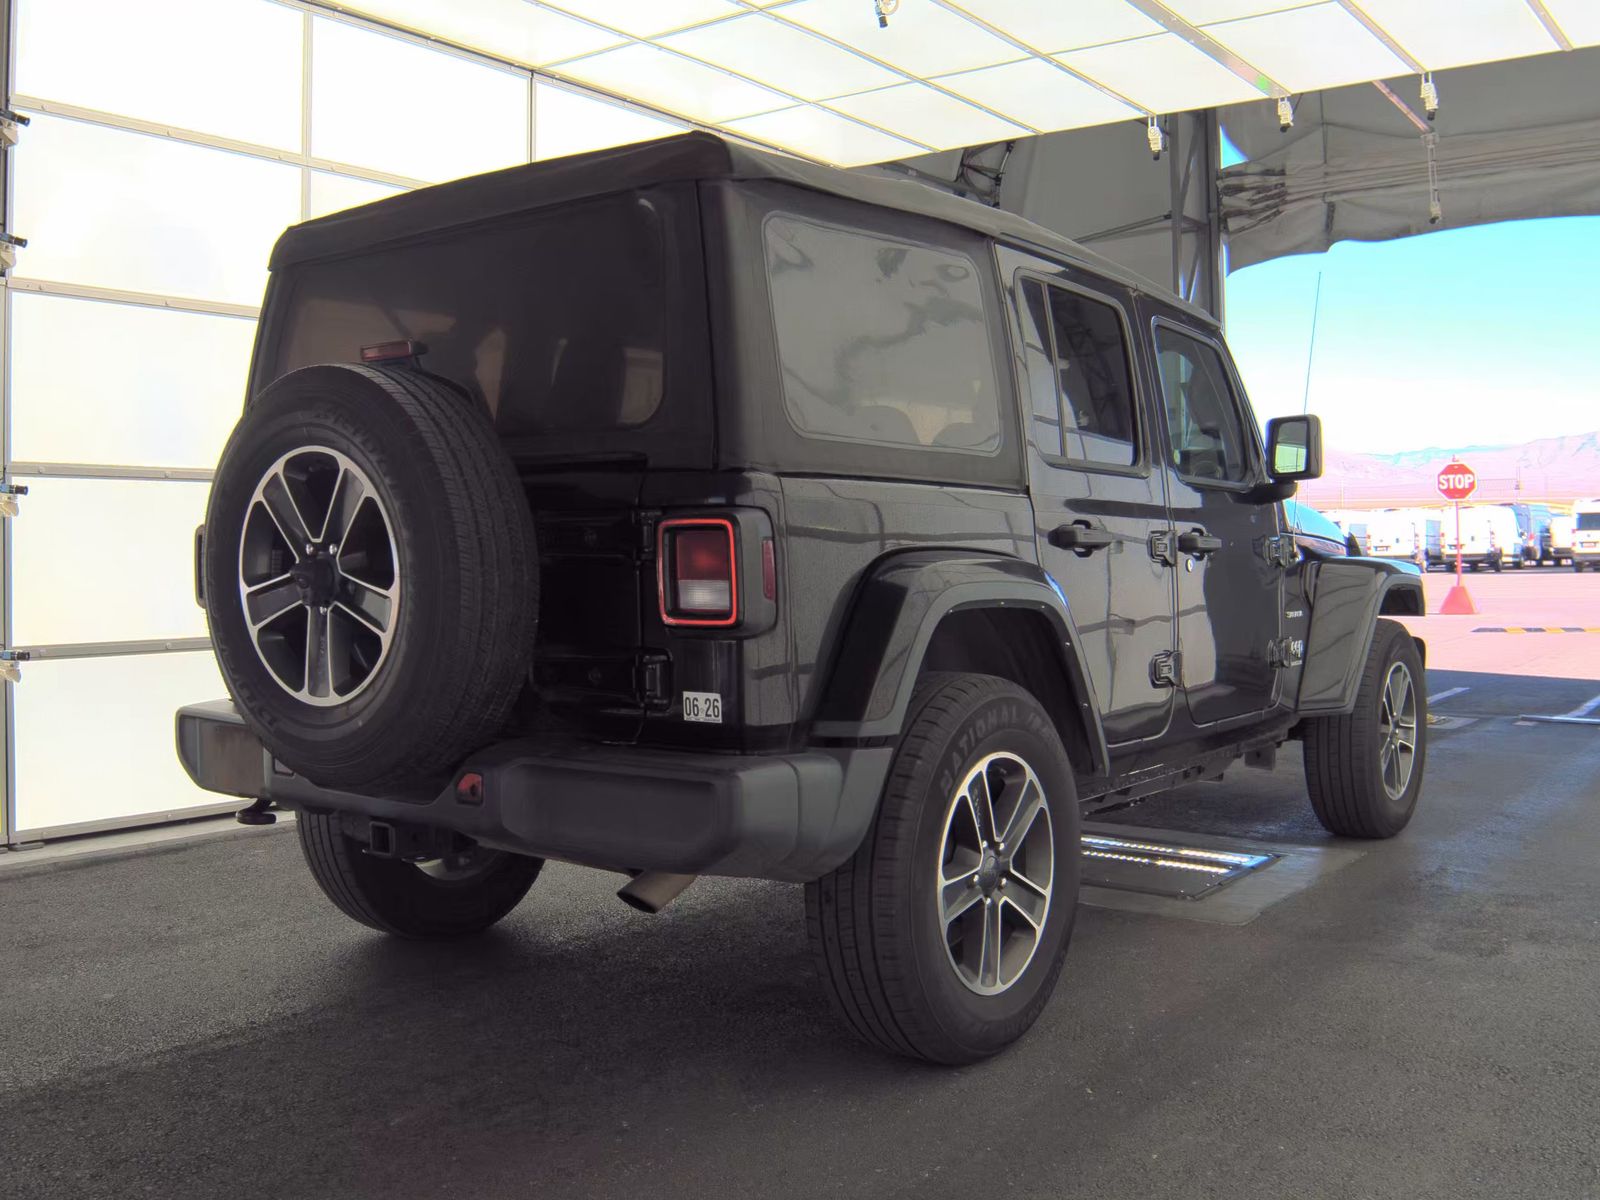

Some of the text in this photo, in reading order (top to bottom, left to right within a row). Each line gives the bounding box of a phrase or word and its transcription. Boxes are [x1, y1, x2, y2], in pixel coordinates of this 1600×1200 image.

[1439, 474, 1474, 490] STOP
[685, 697, 720, 718] 06 26
